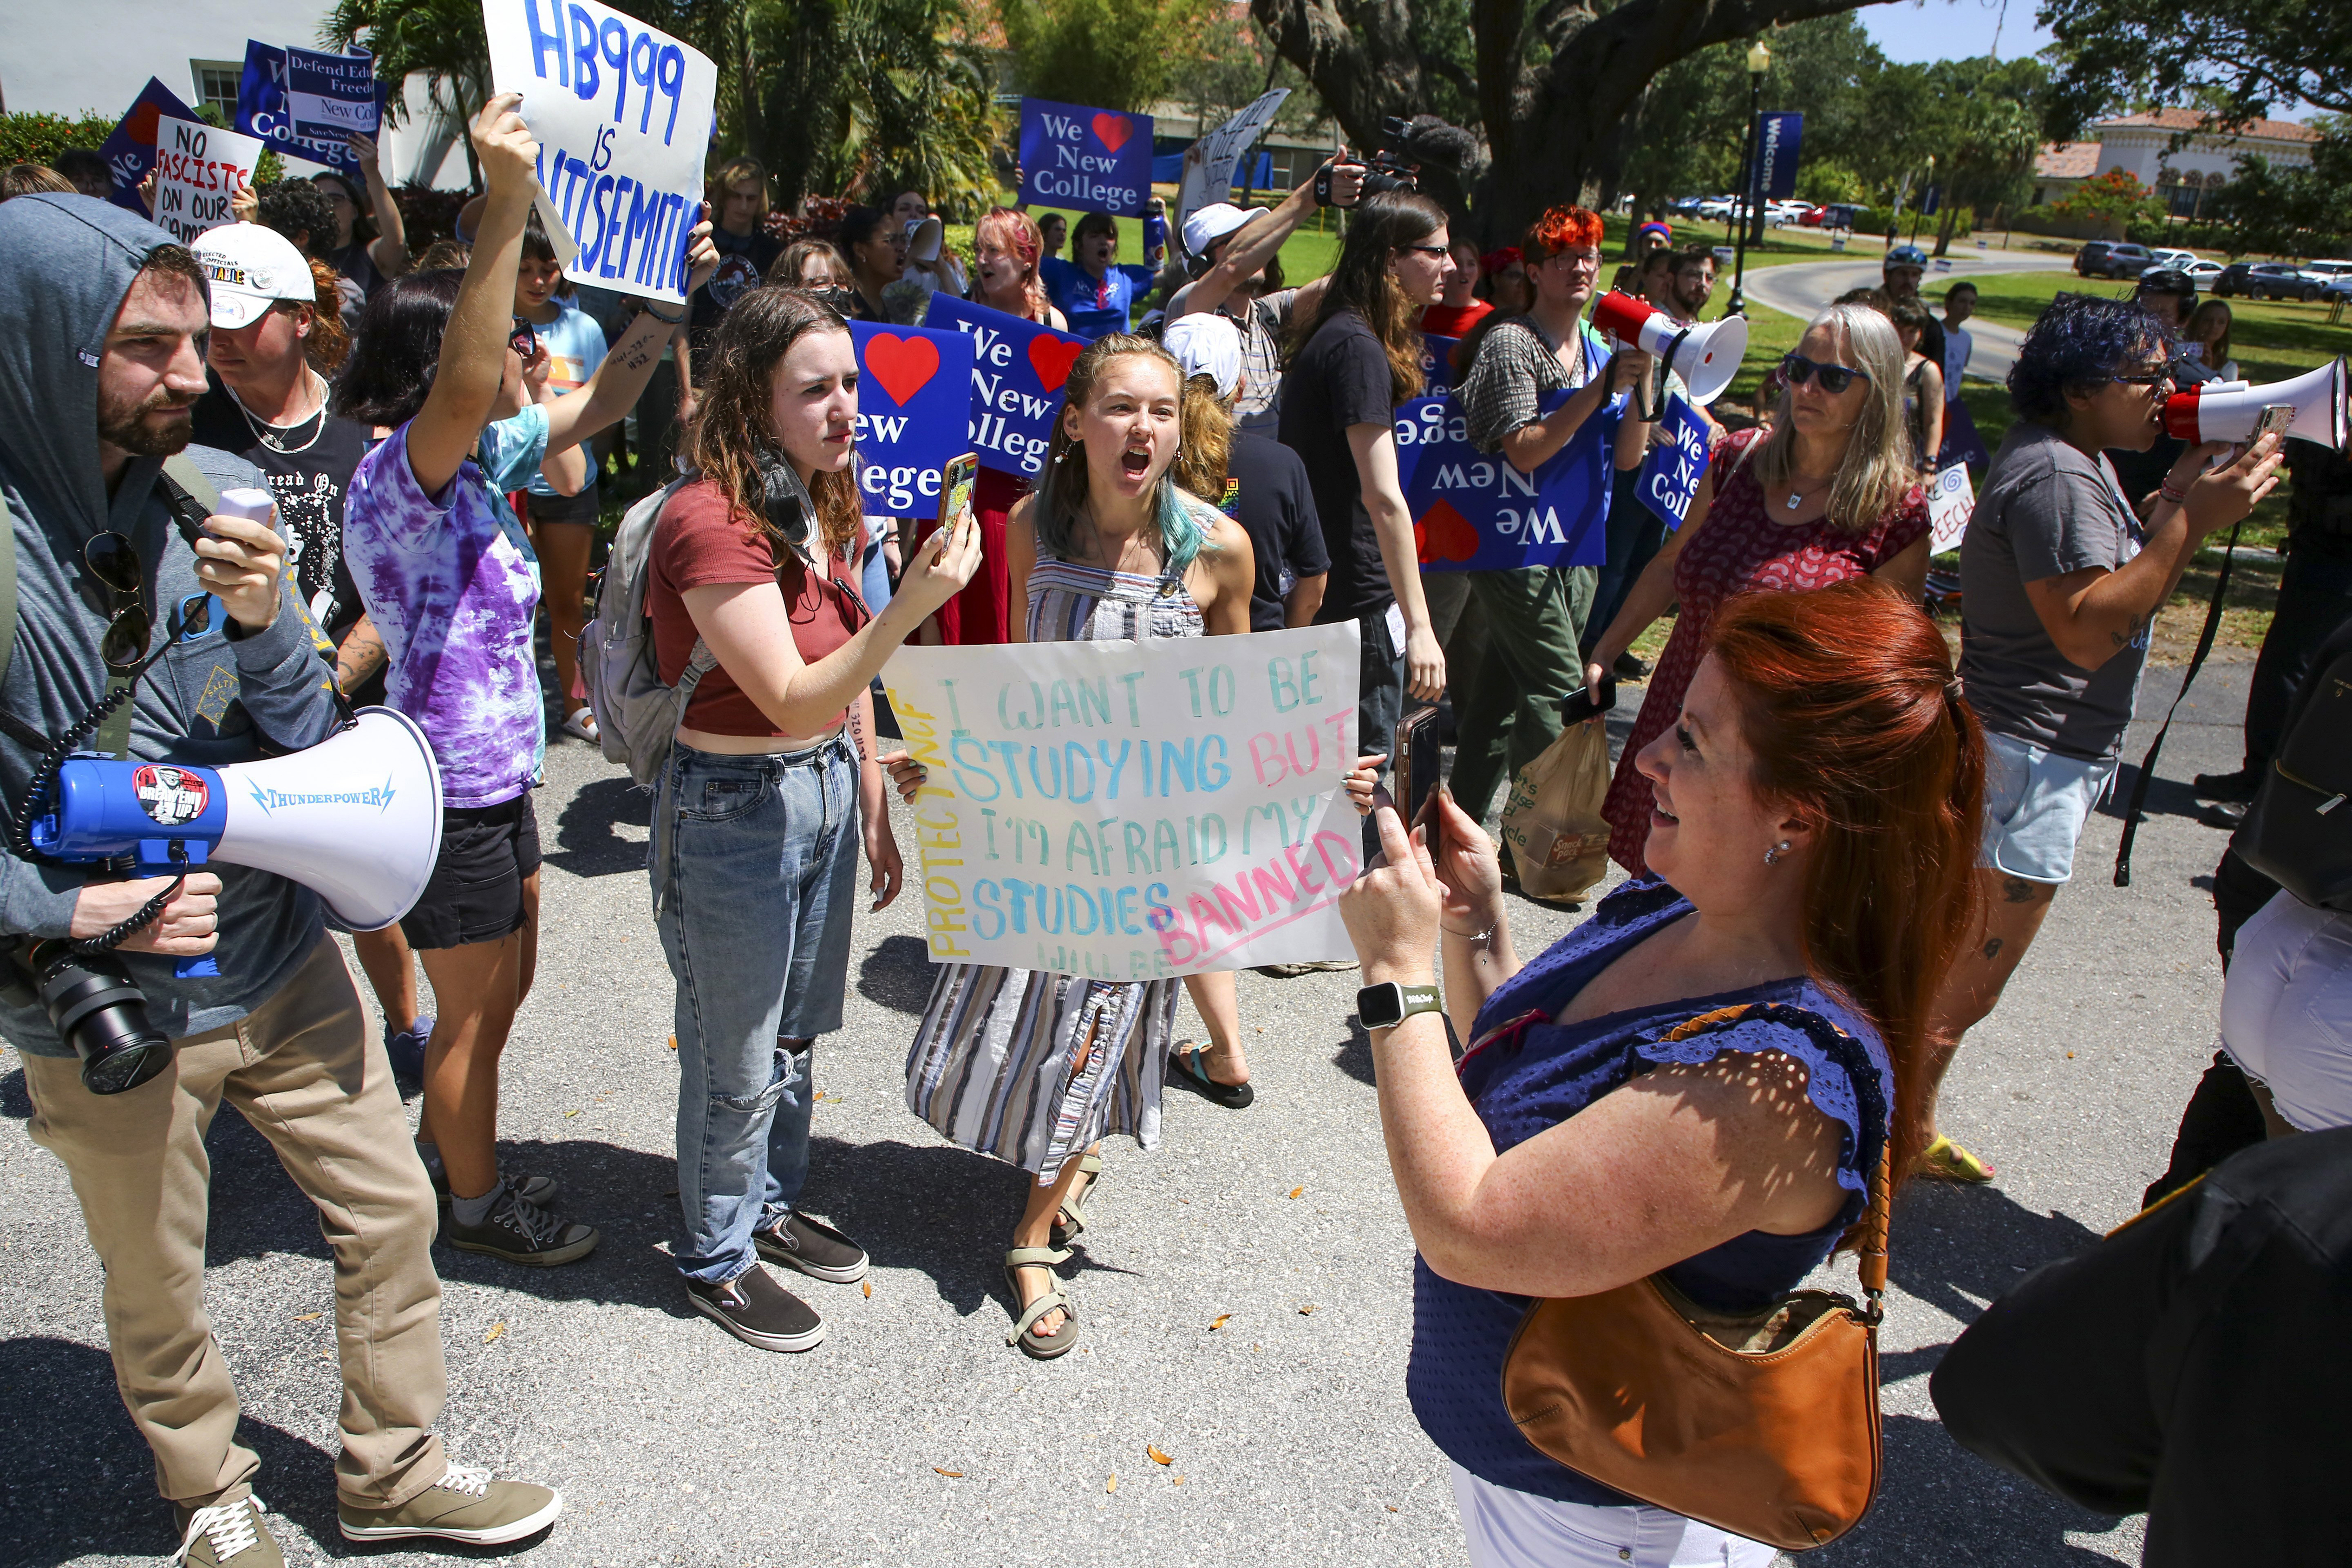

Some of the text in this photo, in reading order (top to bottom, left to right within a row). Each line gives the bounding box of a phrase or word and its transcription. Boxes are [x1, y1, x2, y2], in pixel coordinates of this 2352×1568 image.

[291, 56, 344, 77] Defend
[524, 0, 685, 147] HB999
[321, 98, 351, 118] New
[1041, 113, 1082, 141] We
[176, 125, 207, 159] NO
[590, 124, 615, 172] IS
[1056, 145, 1118, 174] New
[1761, 117, 1782, 192] Welcome
[162, 185, 231, 221] ON OUR
[1034, 170, 1137, 211] College
[205, 265, 244, 284] NTABLE
[206, 257, 239, 266] OFFICIALS
[957, 318, 1013, 367] We
[971, 368, 1053, 421] New
[855, 412, 909, 444] ew
[1677, 417, 1703, 461] We
[259, 468, 339, 497] read On
[1432, 460, 1539, 499] New
[1651, 473, 1692, 521] Coll
[1673, 458, 1700, 496] Ne
[1496, 506, 1569, 546] We
[1930, 495, 1975, 547] PEECH
[207, 680, 234, 697] SALTY
[937, 649, 1323, 737] I WANT TO BE
[886, 688, 948, 768] NCF
[948, 707, 1354, 804] STUDYING BUT
[139, 786, 177, 803] BREAK
[267, 787, 382, 809] THUNDERPOWER
[981, 794, 1316, 877] I'M AFRAID MY
[1553, 839, 1582, 852] Snack
[915, 783, 971, 957] PROTECT
[972, 877, 1174, 941] STUDIES
[1037, 830, 1358, 979] WILL BE BANNED
